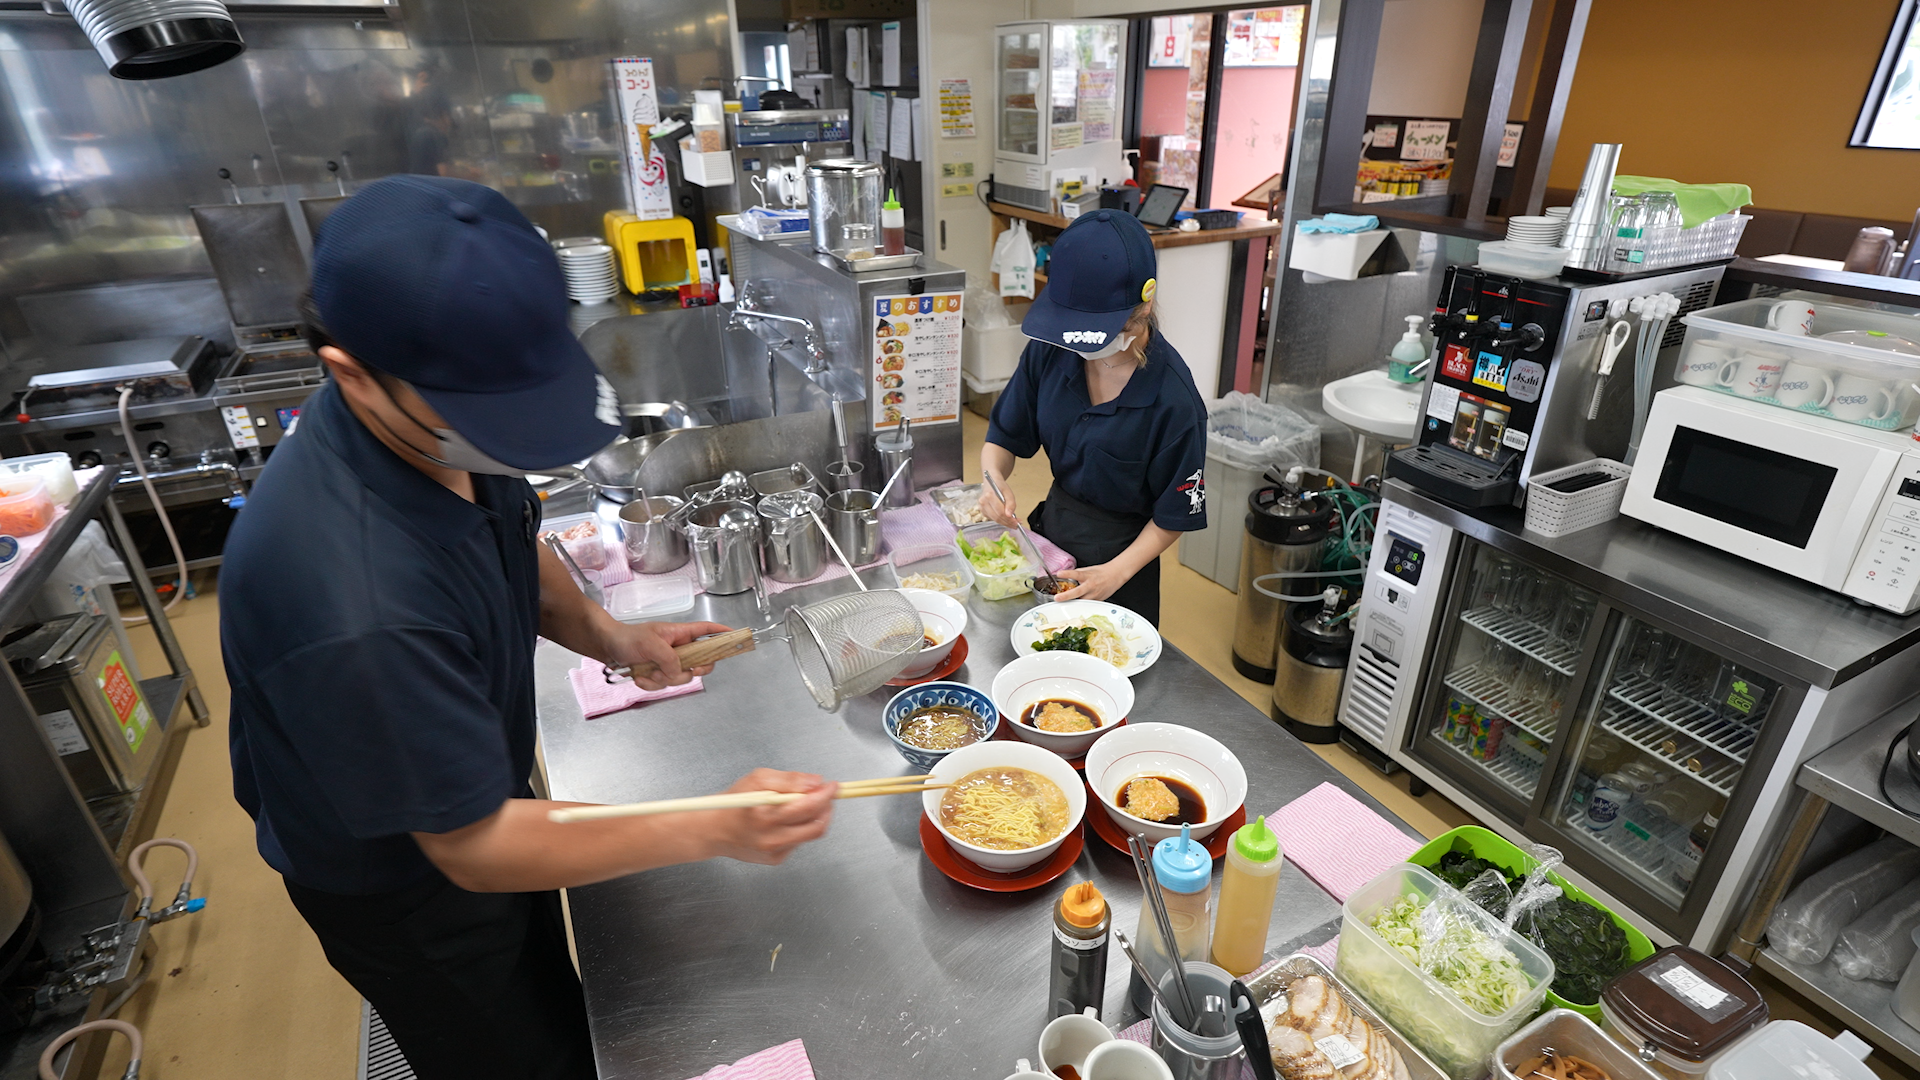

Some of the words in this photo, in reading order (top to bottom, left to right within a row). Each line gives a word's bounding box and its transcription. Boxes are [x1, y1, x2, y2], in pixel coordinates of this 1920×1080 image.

[879, 299, 958, 313] 夏のおすすめ
[1512, 373, 1540, 387] Asahi
[106, 668, 124, 697] SUPER
[1727, 694, 1752, 711] ECO
